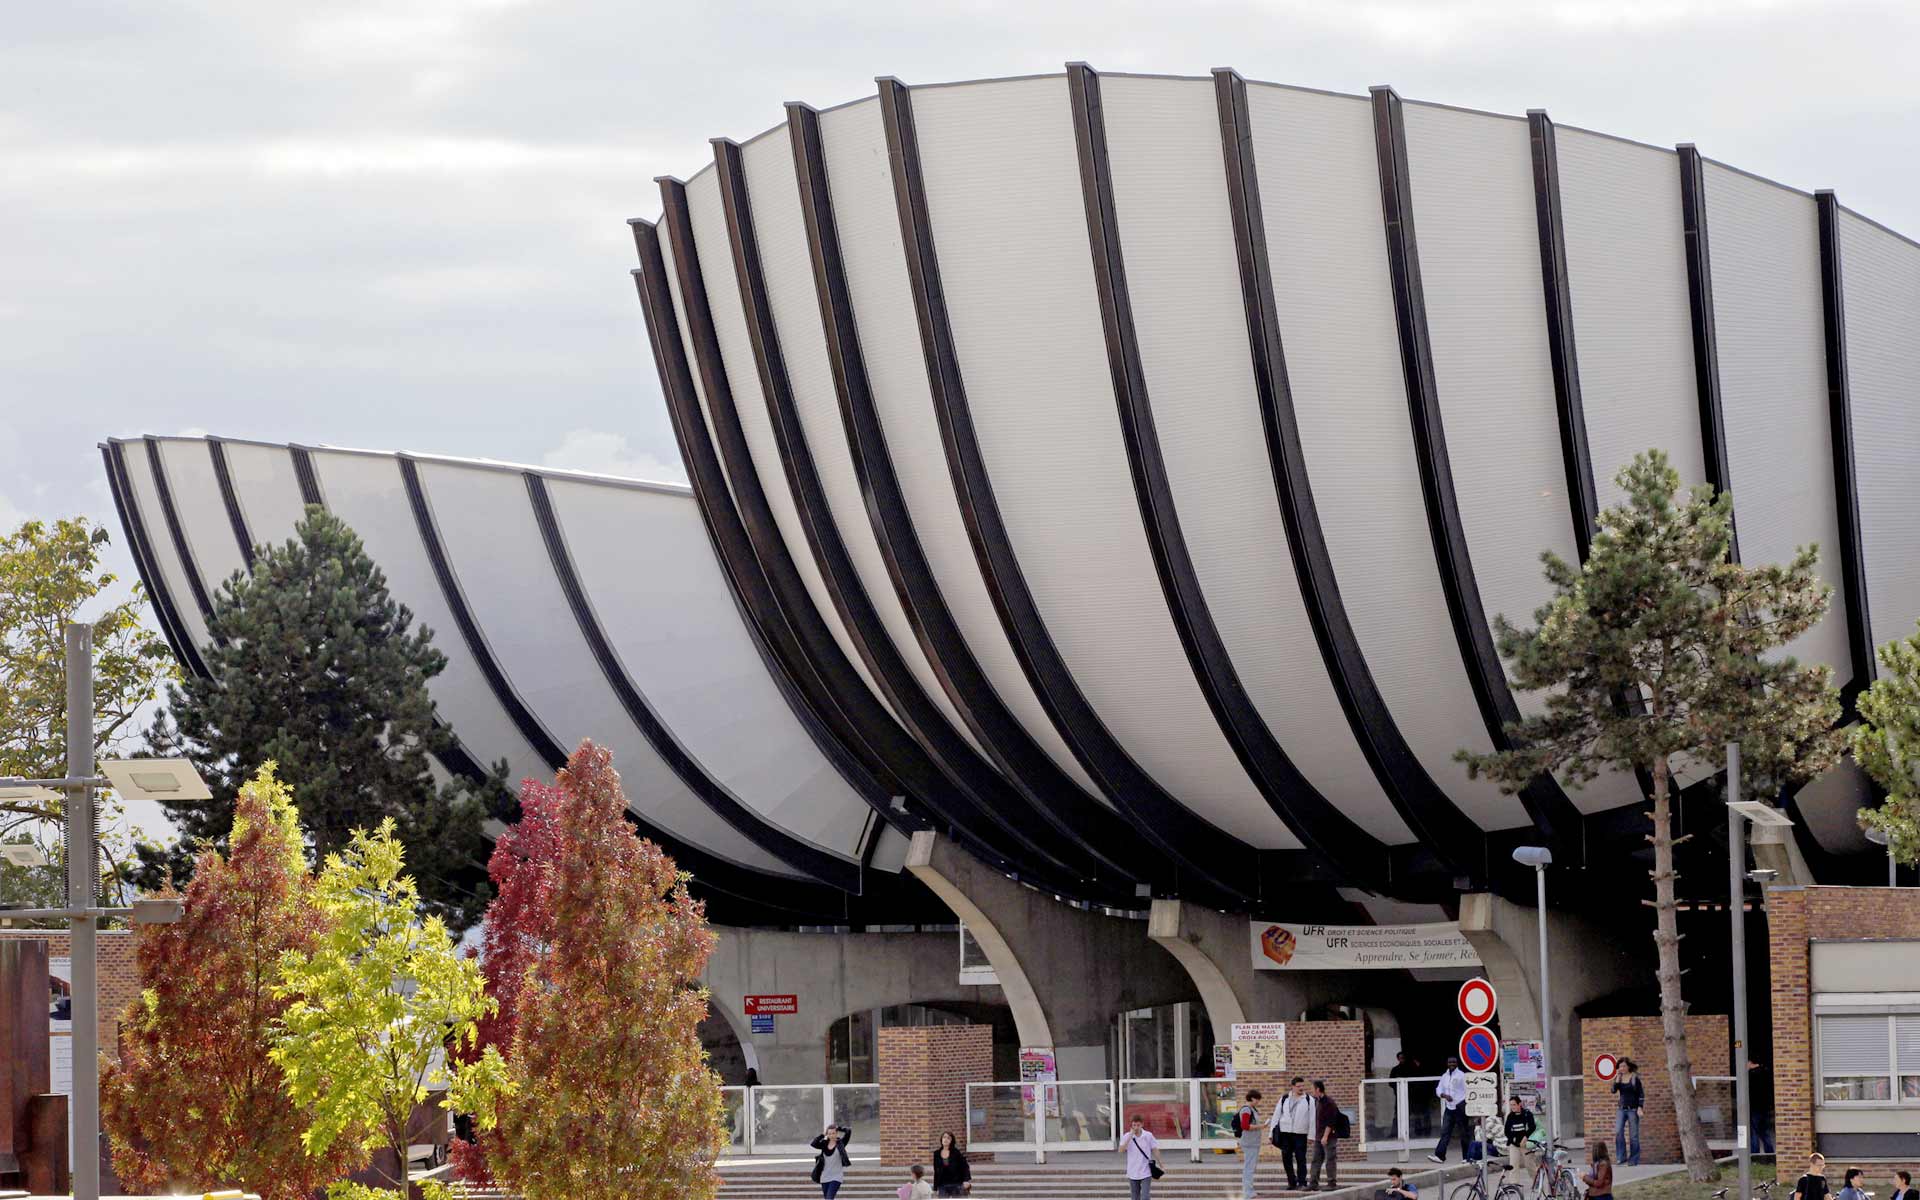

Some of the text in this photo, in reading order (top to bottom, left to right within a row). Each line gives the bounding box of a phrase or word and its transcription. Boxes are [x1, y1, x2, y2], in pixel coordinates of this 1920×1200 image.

[1303, 925, 1416, 936] UFR DROIT ET SCIENCE POLITIQUE
[1326, 937, 1348, 948] UFR
[1350, 940, 1378, 948] SCIENCES
[1453, 938, 1461, 946] ET
[1354, 951, 1406, 964] Apprendre,
[1408, 950, 1420, 961] Se
[1423, 949, 1456, 963] former,
